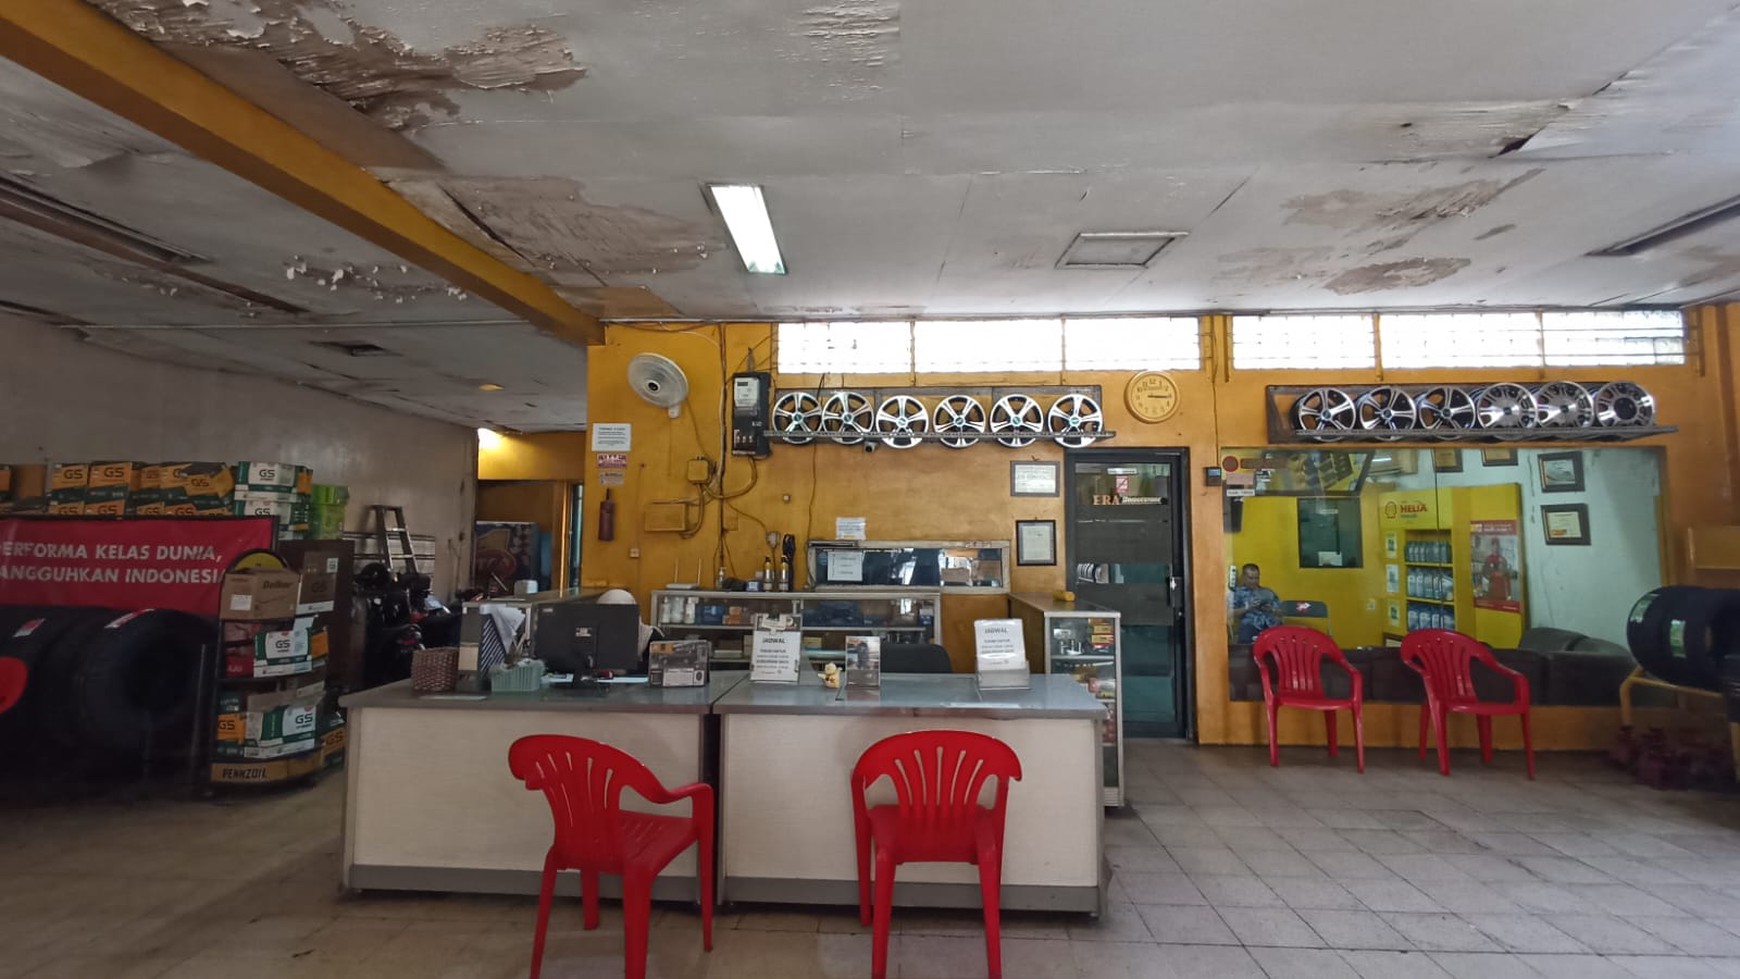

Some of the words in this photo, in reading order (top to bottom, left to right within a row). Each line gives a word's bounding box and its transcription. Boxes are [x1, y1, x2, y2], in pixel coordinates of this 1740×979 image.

[64, 469, 83, 480] GS
[104, 467, 125, 478] GS
[259, 469, 276, 479] GS
[191, 478, 209, 488] GS
[1093, 495, 1120, 506] ERA
[255, 507, 271, 517] GS
[0, 541, 88, 560] ERFORMA
[96, 544, 151, 560] KELAS
[156, 545, 222, 563] DUNIA,
[275, 640, 290, 648] GS
[295, 713, 313, 724] GS
[219, 720, 236, 730] GS
